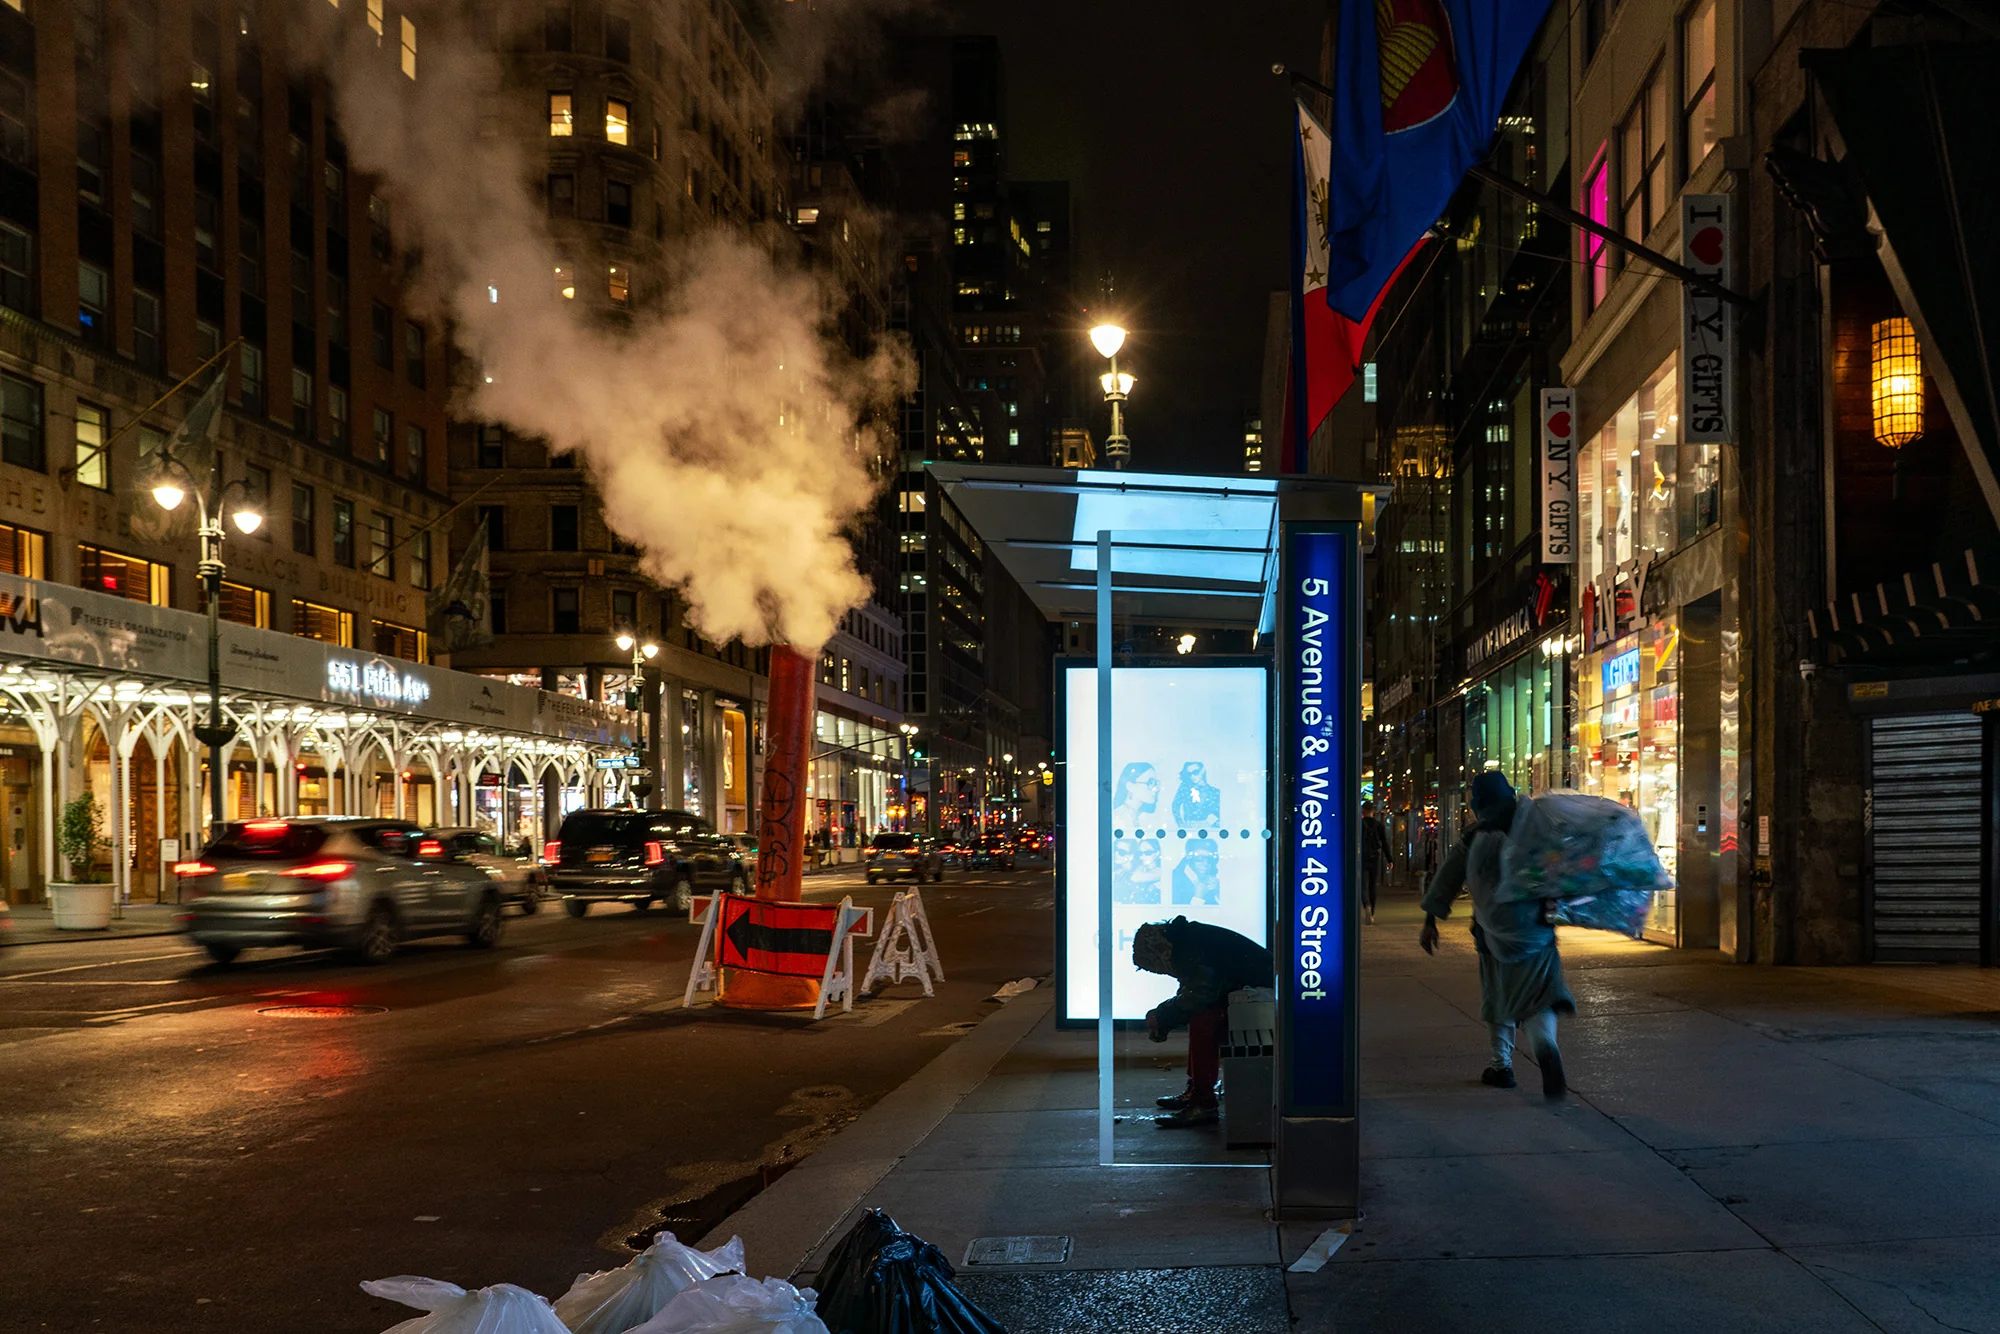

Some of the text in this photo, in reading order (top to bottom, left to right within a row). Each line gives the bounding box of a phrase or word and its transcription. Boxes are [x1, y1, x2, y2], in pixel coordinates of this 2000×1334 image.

[1690, 205, 1722, 224] I
[1547, 395, 1570, 409] I
[1692, 353, 1723, 434] GIFTS
[1549, 499, 1571, 555] GIFTS
[84, 613, 103, 627] THE
[125, 621, 188, 642] ORGANIZATION
[1493, 604, 1531, 652] AMERICA
[327, 660, 431, 703] 551 Fifth Ave
[1300, 577, 1330, 1001] 5 Avenue & West 46 Street
